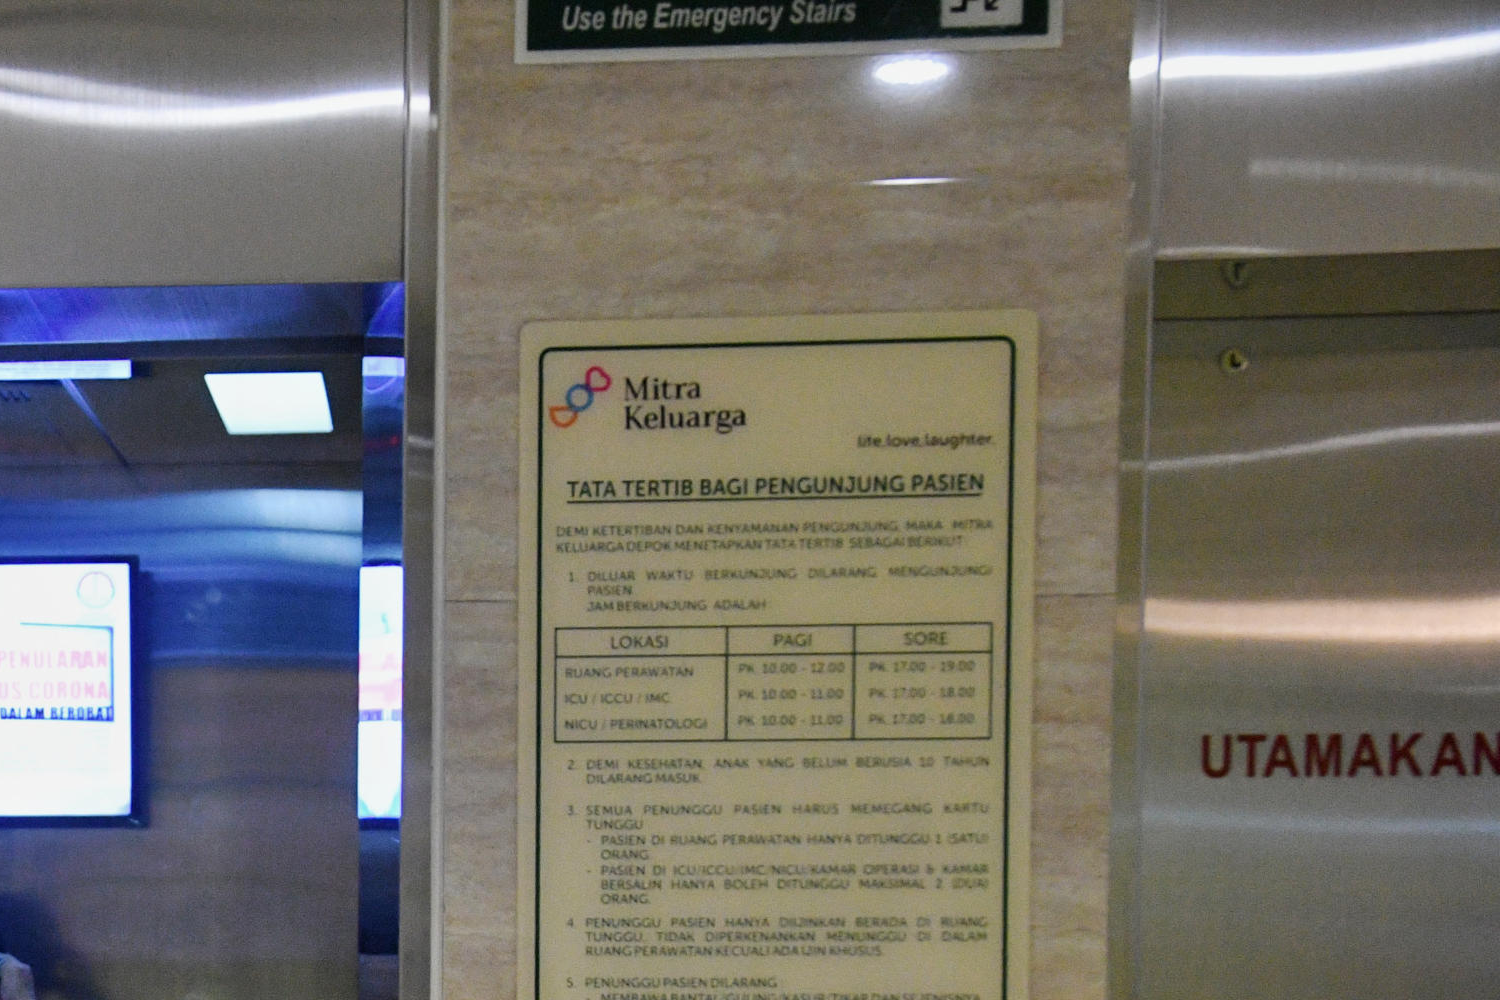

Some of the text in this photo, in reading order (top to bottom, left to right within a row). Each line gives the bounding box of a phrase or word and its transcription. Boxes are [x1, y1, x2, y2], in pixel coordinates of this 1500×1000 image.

[562, 0, 856, 33] Use the Emergency Stairs
[624, 376, 701, 401] Mitra
[625, 404, 747, 434] Keluarga
[567, 473, 985, 498] TATA TERTIB BAGI PENGUNJUNG PASIEN
[556, 525, 588, 537] DEMI
[593, 525, 671, 537] KETERTIBAN
[676, 524, 702, 535] DAN
[708, 522, 798, 535] KENYAMANAN
[556, 541, 624, 553] KELUARGA
[626, 540, 671, 552] DEPOK
[674, 539, 761, 552] MENETAPKAN
[765, 538, 795, 549] TATA
[800, 537, 843, 549] TERTIB
[588, 570, 635, 582] DILUAR
[646, 569, 693, 581] WAKTU
[704, 567, 797, 580] BERKUNJUNG
[808, 566, 877, 579] DILARANG
[587, 601, 614, 612] JAM
[616, 600, 707, 612] BERKUNJUNG
[610, 631, 948, 649] LOKASI PAGI SORE
[565, 667, 612, 678] RUANG
[615, 665, 694, 678] PERAWATAN
[29, 680, 109, 700] CORONA
[565, 693, 588, 704] ICU
[601, 692, 633, 704] ICCU
[645, 692, 669, 704] IMC
[0, 706, 45, 721] DALAM
[564, 719, 598, 730] NICU
[610, 718, 708, 730] PERINATOLOGI
[1202, 731, 1500, 779] UTAMAKAN
[586, 759, 618, 770] DEMI
[714, 758, 749, 769] ANAK
[756, 757, 794, 768] YANG
[586, 773, 652, 784] DILARANG
[586, 804, 633, 815] SEMUA
[644, 804, 723, 815] PENUNGGU
[734, 803, 781, 815] PASIEN
[792, 803, 839, 814] HARUS
[851, 802, 932, 814] MEMEGANG
[586, 818, 644, 830] TUNGGU
[601, 834, 646, 846] PASIEN
[652, 834, 665, 845] DI
[670, 834, 717, 845] RUANG
[722, 833, 801, 845] PERAWATAN
[806, 833, 852, 844] HANYA
[601, 849, 649, 860] ORANG
[601, 864, 646, 876] PASIEN
[653, 864, 666, 875] DI
[601, 879, 662, 890] BERSALIN
[671, 879, 715, 890] HANYA
[724, 879, 769, 890] BOLEH
[585, 916, 987, 928] PENUNGGU PASIEN HANYA BERADA DI RUANG
[656, 930, 988, 942] TIDAK DIPERKENANKAN MENUNGGU DI DALAM
[585, 946, 632, 957] RUANG
[634, 946, 713, 957] PERAWATAN
[715, 945, 769, 956] KECUALI
[771, 945, 799, 956] ADA
[585, 977, 777, 989] PENUNGGU PASIEN DILARANG
